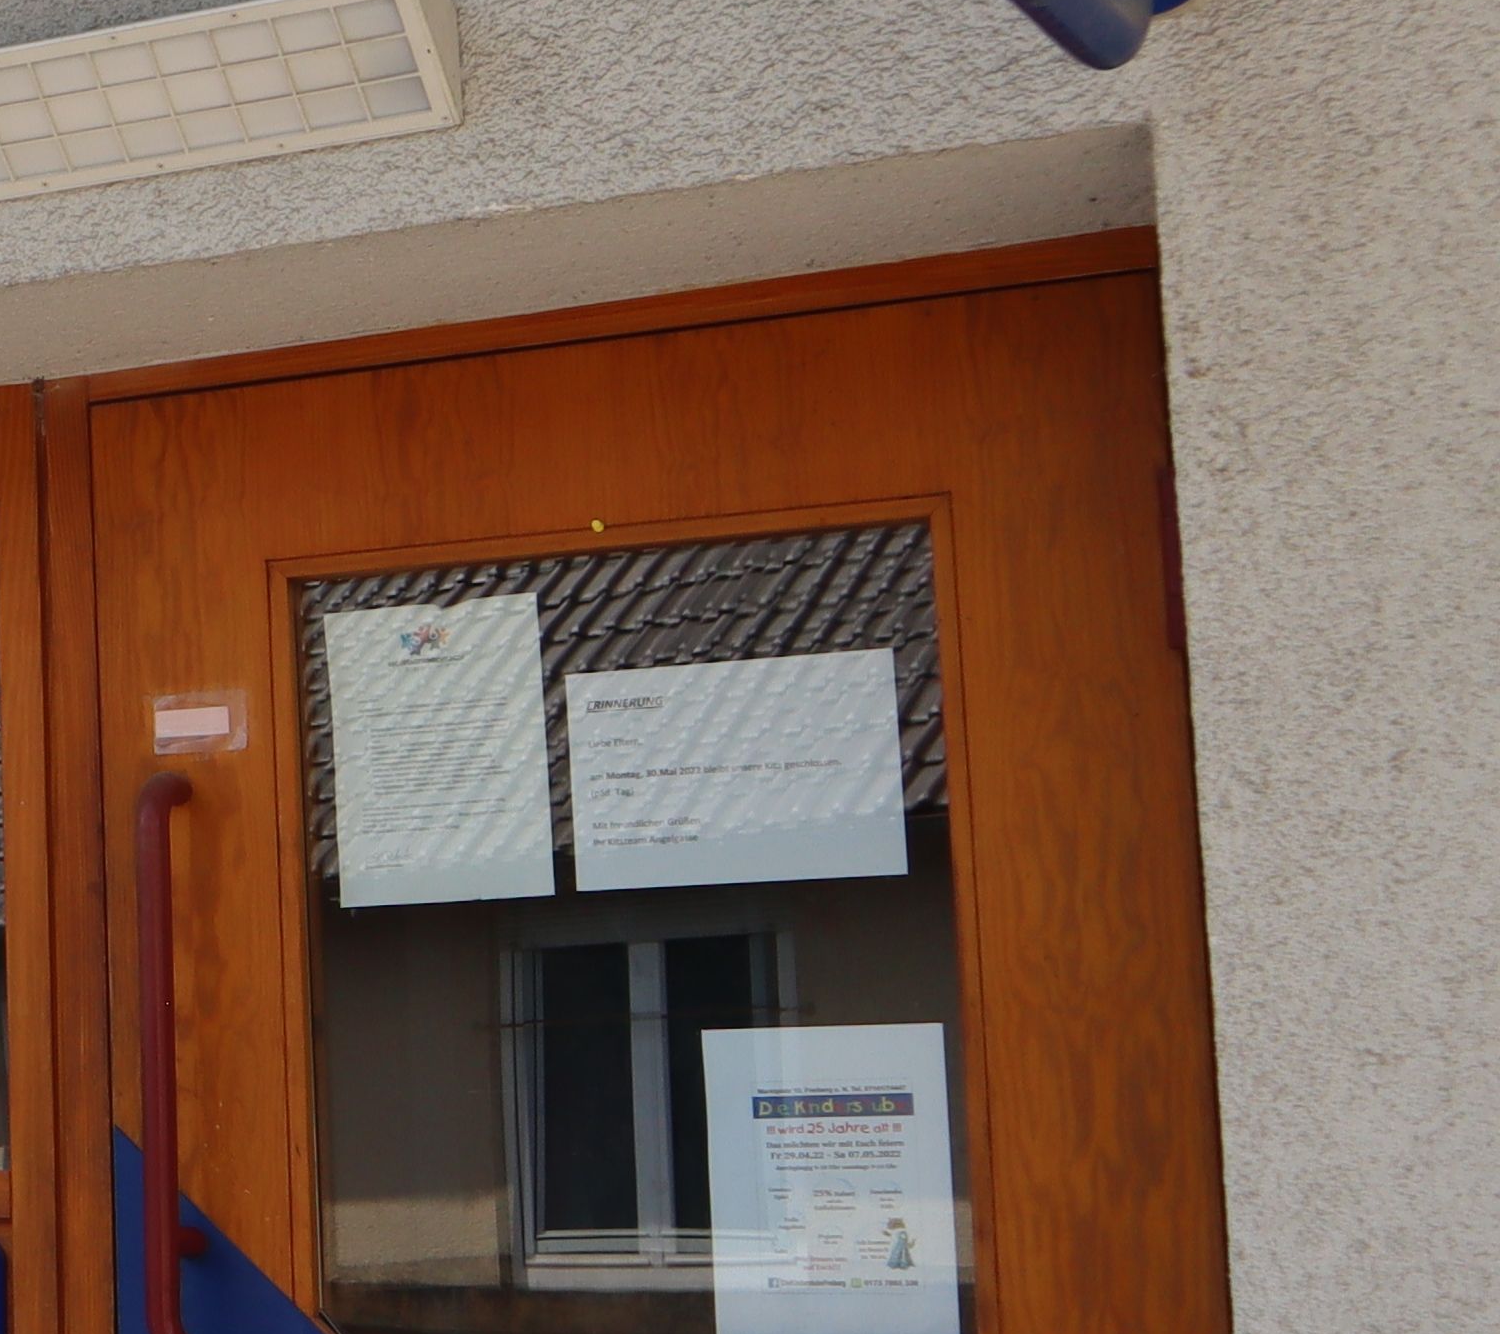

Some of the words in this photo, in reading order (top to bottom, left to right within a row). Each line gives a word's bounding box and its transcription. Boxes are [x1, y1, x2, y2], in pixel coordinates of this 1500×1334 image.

[587, 696, 663, 711] ERINNERUNG
[606, 770, 643, 781] Montag,
[778, 1124, 804, 1134] wird
[807, 1122, 825, 1134] 25
[828, 1122, 871, 1134] Jahre
[873, 1123, 888, 1133] alt
